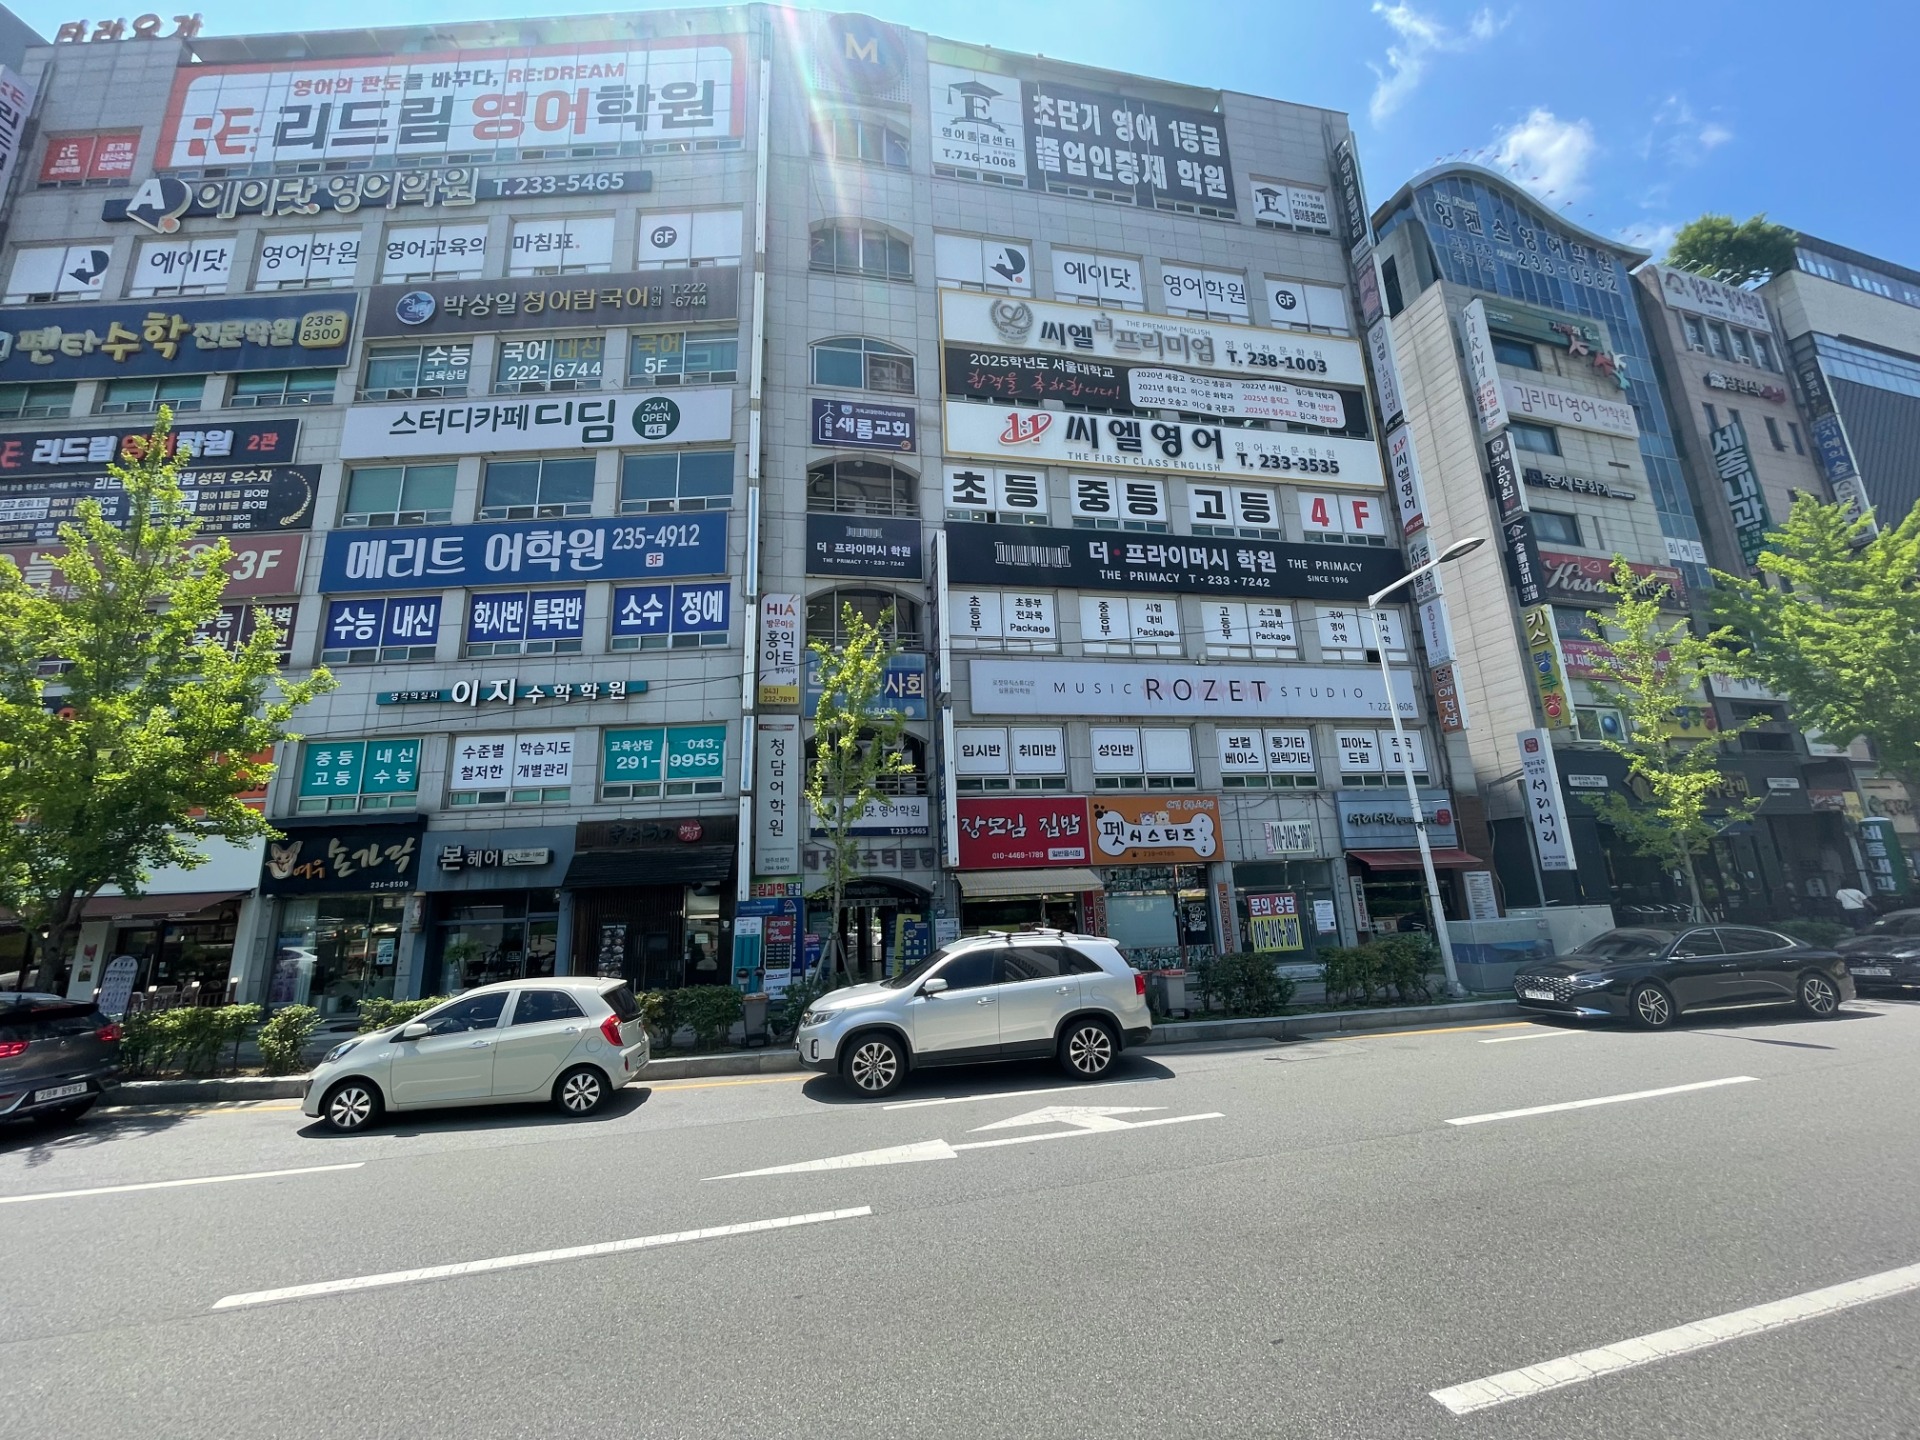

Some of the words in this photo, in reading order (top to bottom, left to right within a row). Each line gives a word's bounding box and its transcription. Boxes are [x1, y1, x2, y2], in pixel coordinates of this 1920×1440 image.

[293, 77, 353, 97] 영어의
[361, 72, 424, 92] 판도를
[508, 62, 624, 83] RE:DREAM
[272, 96, 453, 151] 리드림
[1032, 94, 1102, 136] 초단기
[1111, 108, 1160, 147] 영어
[1168, 120, 1221, 158] 1등급
[941, 126, 1016, 149] 영어종결센터
[328, 167, 480, 214] 영어학원
[1176, 158, 1228, 200] 학원
[262, 241, 361, 270] 영어학원
[386, 235, 488, 261] 영어교육의
[1162, 273, 1246, 305] 영어학원
[441, 291, 519, 319] 박상일
[1039, 319, 1094, 351] 씨엘
[426, 345, 471, 367] 수능
[503, 339, 548, 363] 국어
[557, 336, 601, 359] 내신
[643, 357, 668, 374] 5F
[969, 352, 1050, 371] 2025학년도
[1052, 357, 1116, 379] 서울대학교
[1247, 351, 1329, 375] 238-1003
[424, 369, 468, 382] 교육상담
[388, 403, 529, 435] 스터디카페
[534, 398, 616, 444] 디딤
[640, 411, 671, 424] OPEN
[835, 416, 911, 440] 새롬교회
[32, 434, 118, 466] 리드림
[247, 431, 279, 452] 2관
[1064, 413, 1226, 461] 씨엘영어
[1067, 450, 1092, 462] THE
[1094, 452, 1129, 466] FIRST
[1132, 456, 1169, 469] CLASS
[1173, 459, 1222, 473] ENGLISH
[1258, 453, 1341, 476] 233-3535
[197, 472, 227, 486] 성적
[229, 469, 273, 485] 우수자
[1395, 452, 1417, 511] 씨엘영어
[1712, 420, 1764, 530] 세종내과
[951, 469, 1039, 510] 초등
[1076, 479, 1160, 517] 중등
[1193, 487, 1271, 525] 고등
[345, 534, 467, 580] 메리트
[484, 527, 606, 574] 어학원
[611, 523, 701, 552] 235-4912
[834, 542, 888, 557] 프라이머시
[889, 544, 912, 558] 학원
[1124, 543, 1230, 571] 프라이머시
[1236, 548, 1278, 573] 학원
[232, 548, 283, 582] 3F
[1099, 569, 1122, 581] THE
[1124, 570, 1180, 584] PRIMACY
[1288, 558, 1309, 570] THE
[1315, 560, 1363, 573] PRIMACY
[1307, 574, 1330, 583] SINCE
[530, 596, 583, 632] 특목반
[620, 594, 664, 627] 소수
[680, 588, 724, 625] 정예
[968, 595, 983, 632] 초등부
[1014, 597, 1043, 608] 초등부
[1145, 602, 1162, 613] 시험
[1258, 607, 1282, 618] 소그룹
[333, 607, 377, 641] 수능
[392, 602, 436, 638] 내신
[473, 600, 524, 634] 학사반
[1014, 610, 1044, 621] 전과목
[1098, 600, 1112, 636] 중등부
[1146, 615, 1163, 626] 대비
[1219, 605, 1233, 640] 고등부
[1328, 609, 1344, 620] 국어
[1009, 623, 1051, 634] Package
[1136, 627, 1175, 638] Package
[1255, 631, 1292, 642] Package
[1330, 622, 1346, 632] 영어
[1427, 605, 1440, 648] ROZET
[765, 630, 795, 649] 홍익
[1331, 633, 1348, 644] 수학
[765, 649, 796, 667] 아트
[451, 678, 517, 707] 이지
[523, 680, 628, 705] 수학학원
[883, 671, 925, 699] 사회
[1053, 681, 1133, 695] MUSIC
[1146, 677, 1267, 703] ROZET
[1280, 686, 1365, 699] STUDIO
[462, 742, 505, 760] 수준별
[519, 739, 572, 756] 학습지도
[610, 739, 654, 753] 교육상담
[961, 743, 1001, 758] 입시반
[1017, 742, 1057, 758] 취미반
[1097, 742, 1135, 758] 성인반
[1228, 735, 1253, 750] 보컬
[1271, 735, 1306, 750] 통기타
[1339, 736, 1374, 750] 피아노
[314, 749, 355, 767] 중등
[375, 747, 414, 765] 내신
[1223, 751, 1260, 766] 베이스
[1269, 750, 1313, 766] 일렉기타
[1347, 751, 1371, 766] 드럼
[311, 769, 352, 787] 고등
[372, 767, 413, 784] 수능
[460, 762, 504, 781] 철저한
[516, 761, 569, 778] 개별관리
[769, 737, 787, 838] 청담어학원
[879, 804, 921, 819] 영어학원
[1531, 778, 1558, 845] 서리서리
[961, 812, 1027, 839] 장모님
[1038, 811, 1081, 838] 집밥
[466, 848, 499, 868] 헤어
